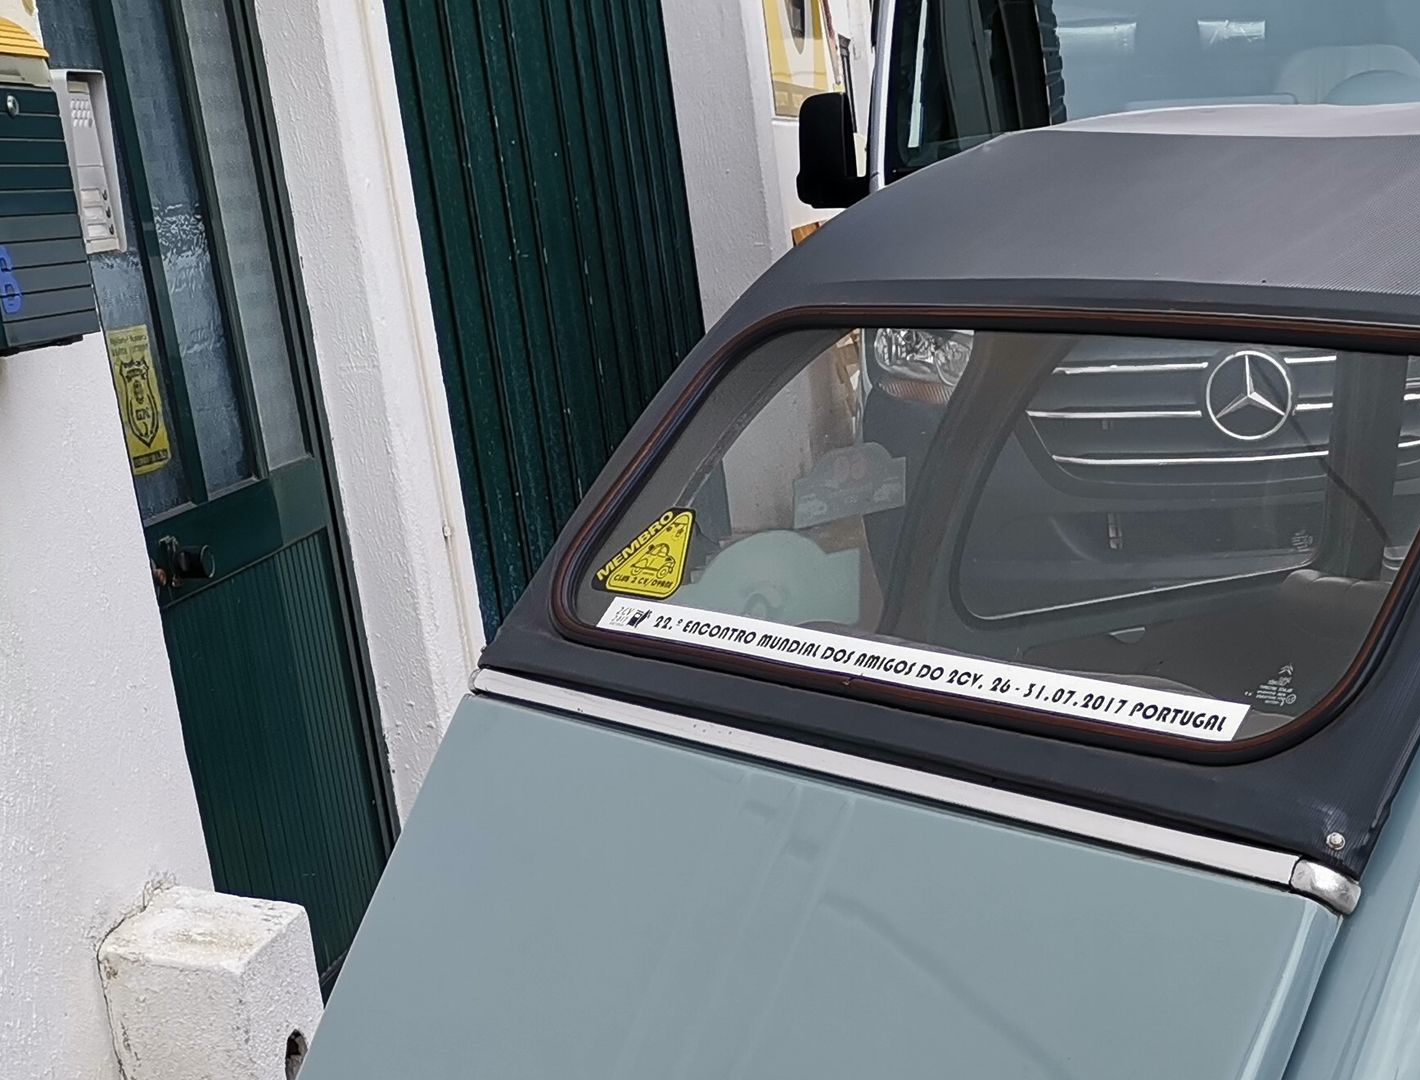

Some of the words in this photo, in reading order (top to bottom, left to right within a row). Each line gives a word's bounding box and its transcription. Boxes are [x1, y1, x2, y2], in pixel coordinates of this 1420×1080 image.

[596, 511, 673, 581] MEMBRO
[683, 620, 757, 645] ENCONTRO
[757, 633, 821, 658] MUNDIAL
[820, 646, 855, 664] DOS
[854, 653, 917, 676] AMIGOS
[916, 664, 945, 681] DO
[989, 676, 1012, 693] 26
[1023, 683, 1129, 715] 31.07.2017
[1128, 702, 1228, 733] PORTUGAL
